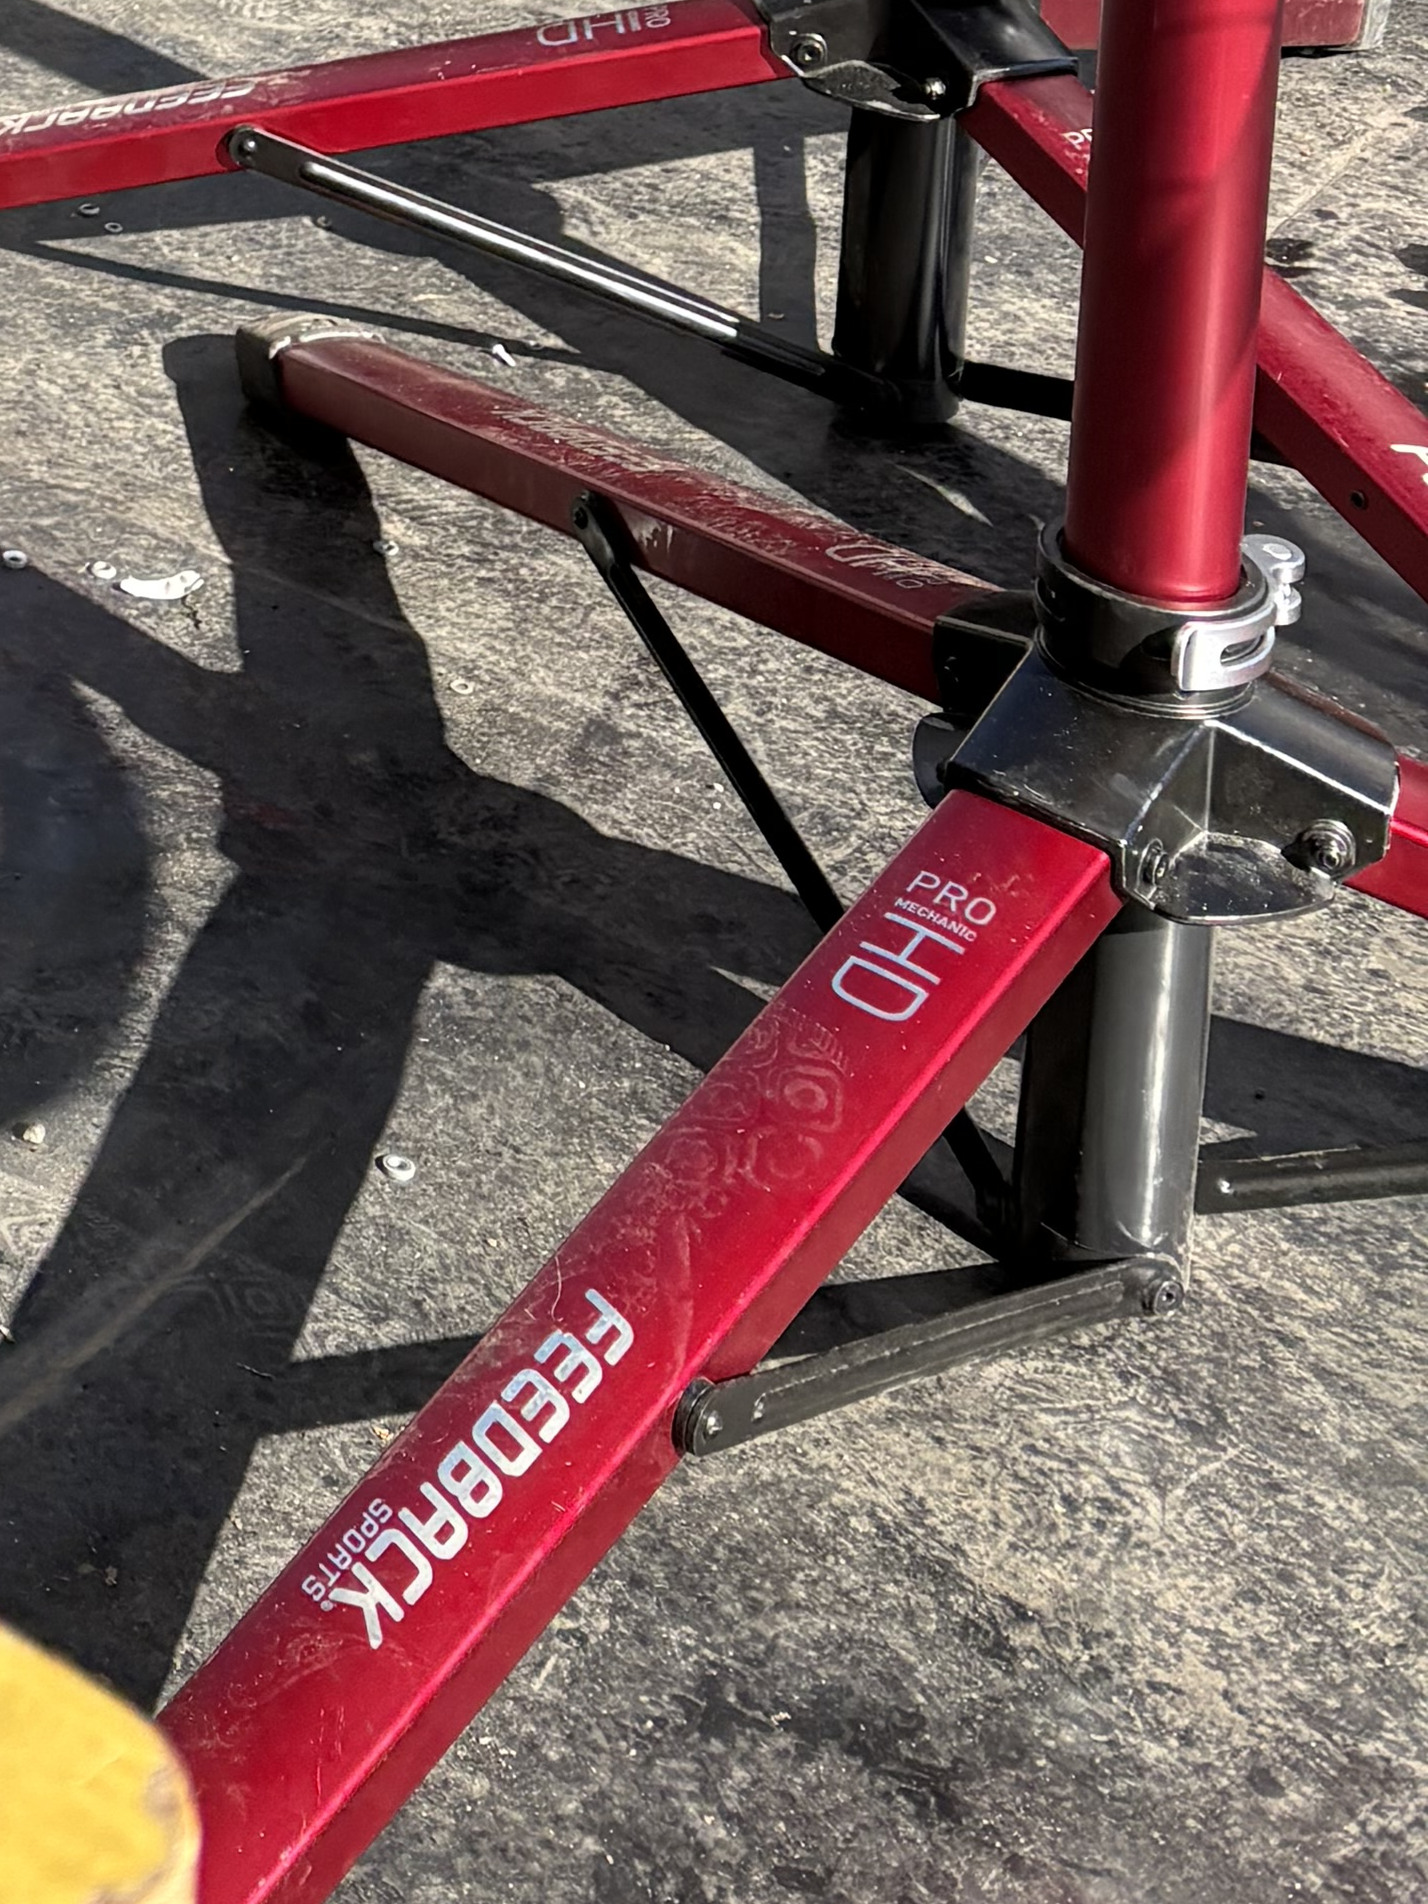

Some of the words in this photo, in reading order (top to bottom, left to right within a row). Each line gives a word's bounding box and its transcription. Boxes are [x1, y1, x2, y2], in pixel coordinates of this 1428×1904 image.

[893, 896, 979, 943] MECHANIC
[905, 869, 998, 926] PRO
[831, 910, 966, 1023] HD
[328, 1288, 635, 1651] FEEDBACK
[300, 1496, 394, 1604] SPORTS
